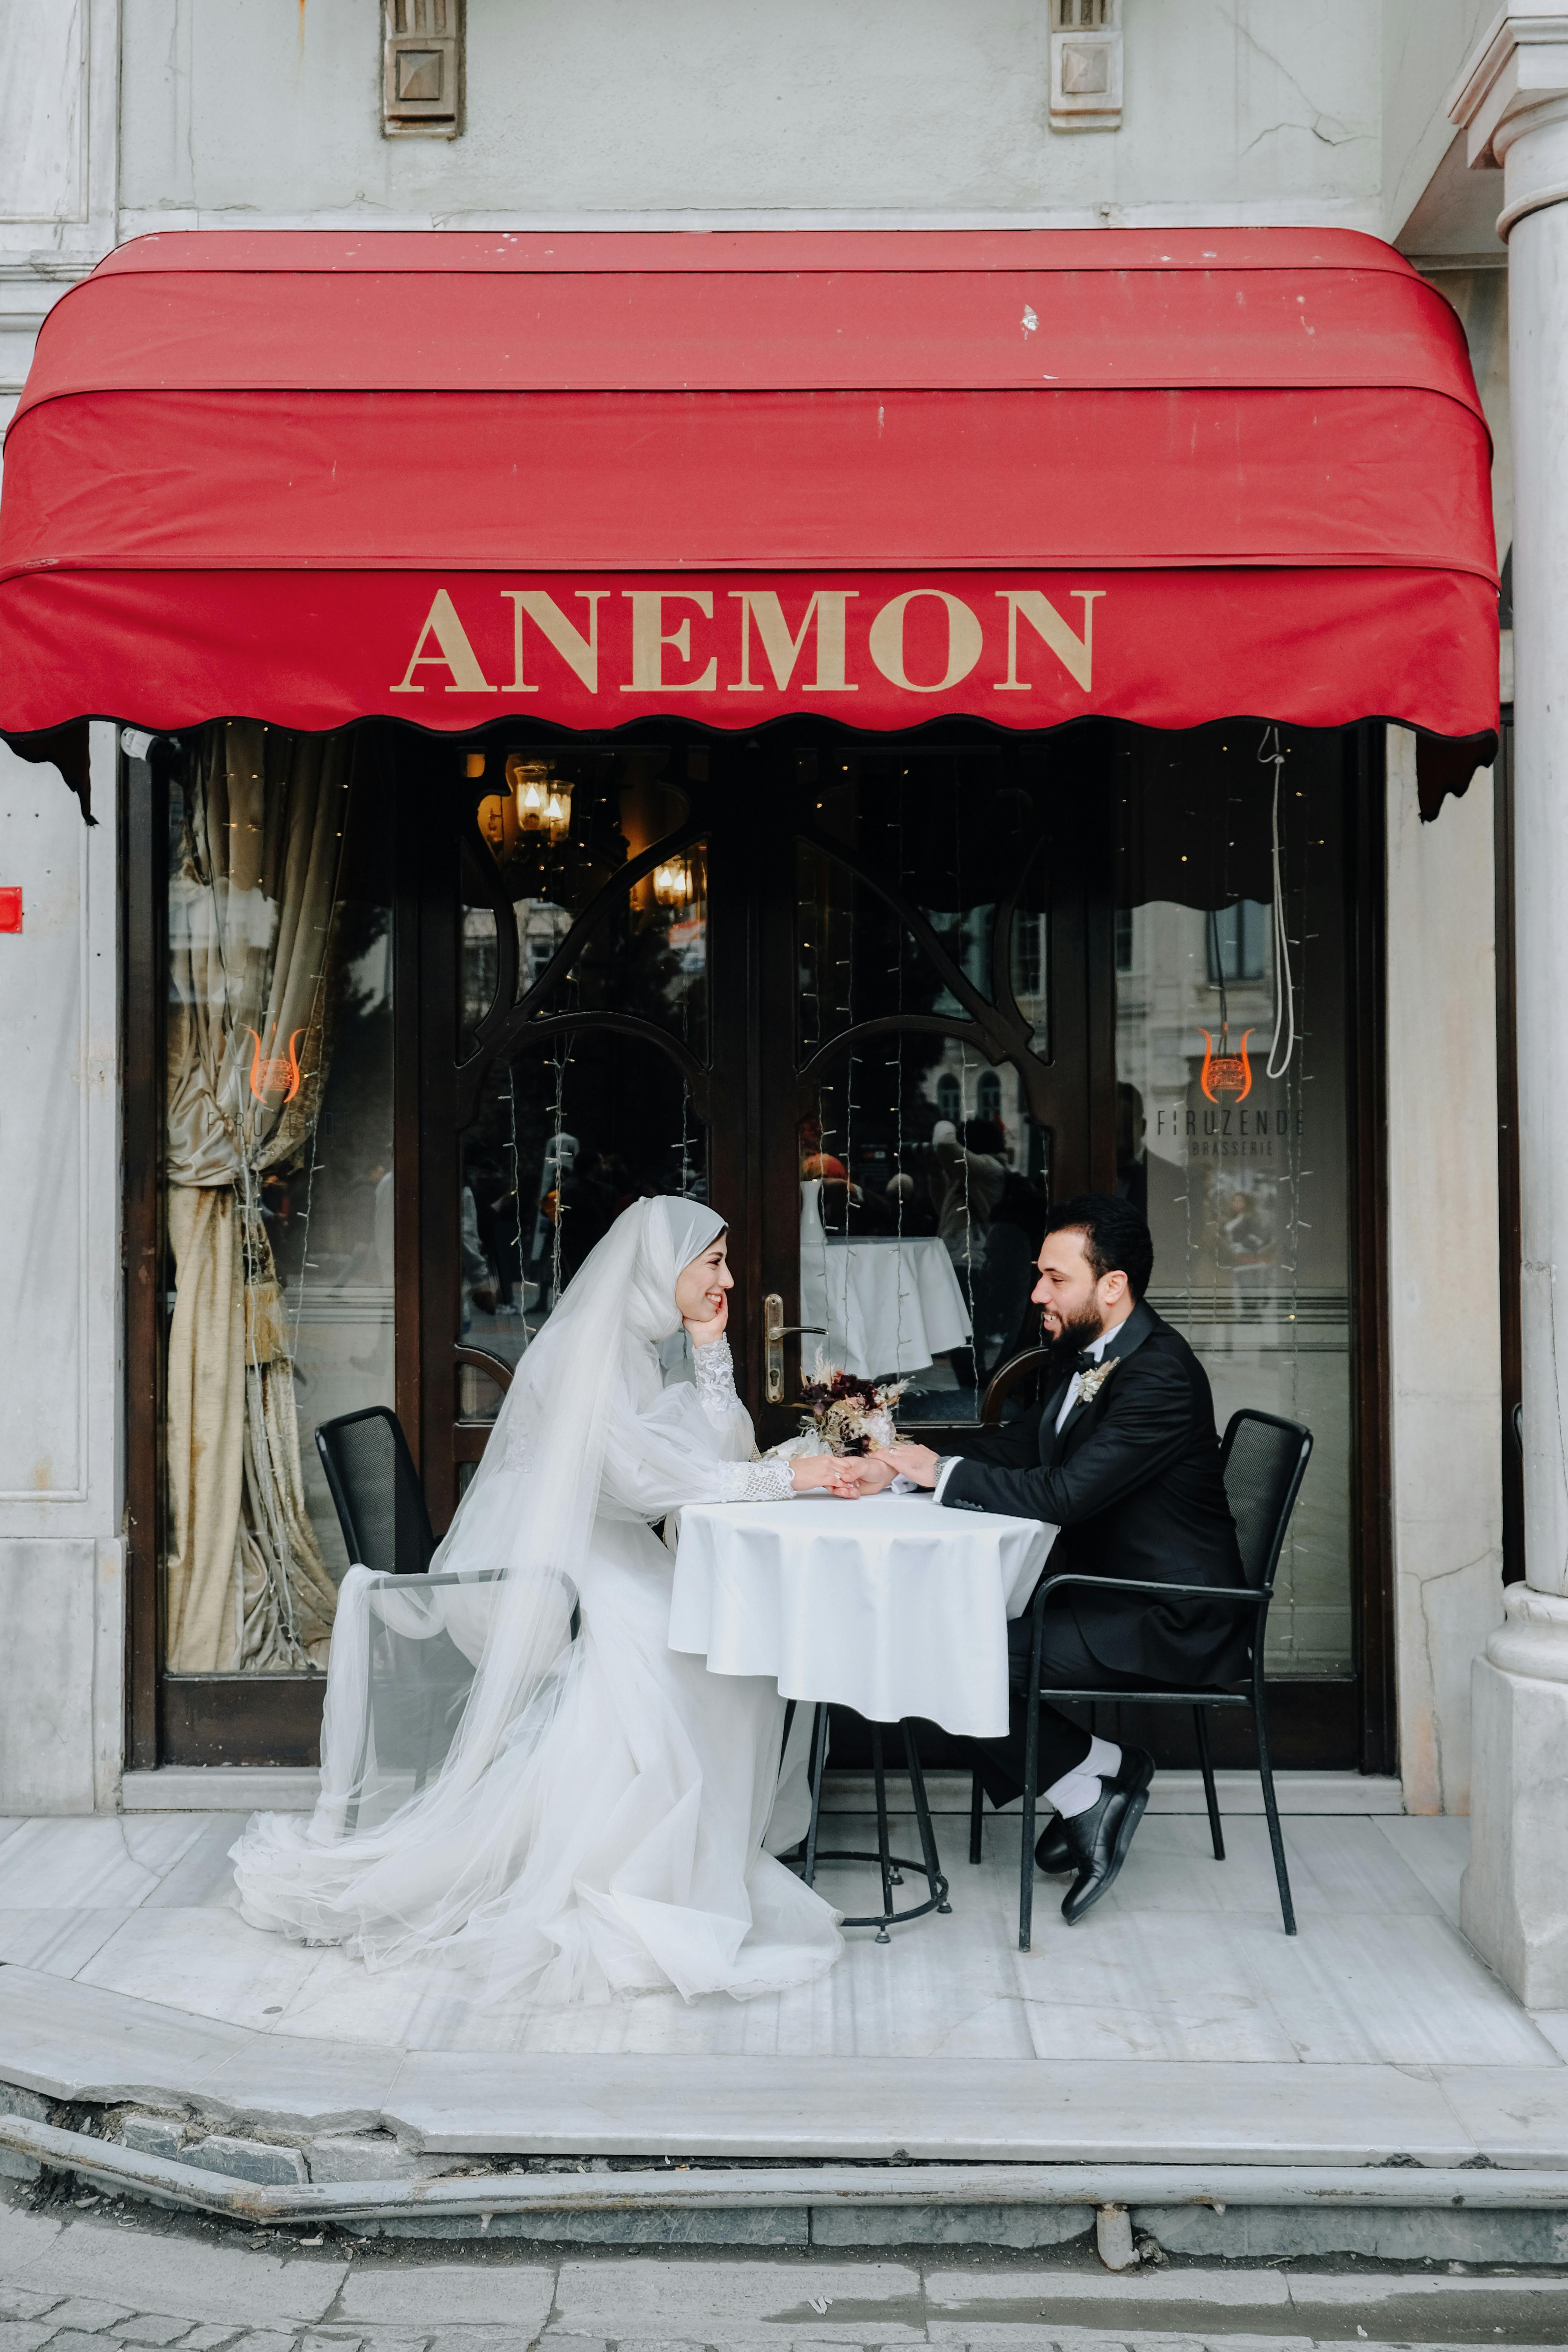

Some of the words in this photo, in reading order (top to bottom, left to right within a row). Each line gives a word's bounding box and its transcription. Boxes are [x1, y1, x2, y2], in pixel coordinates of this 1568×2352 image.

[390, 589, 1105, 693] ANEMON
[207, 1112, 350, 1137] FRUED
[1193, 1142, 1273, 1156] BRASSERIE
